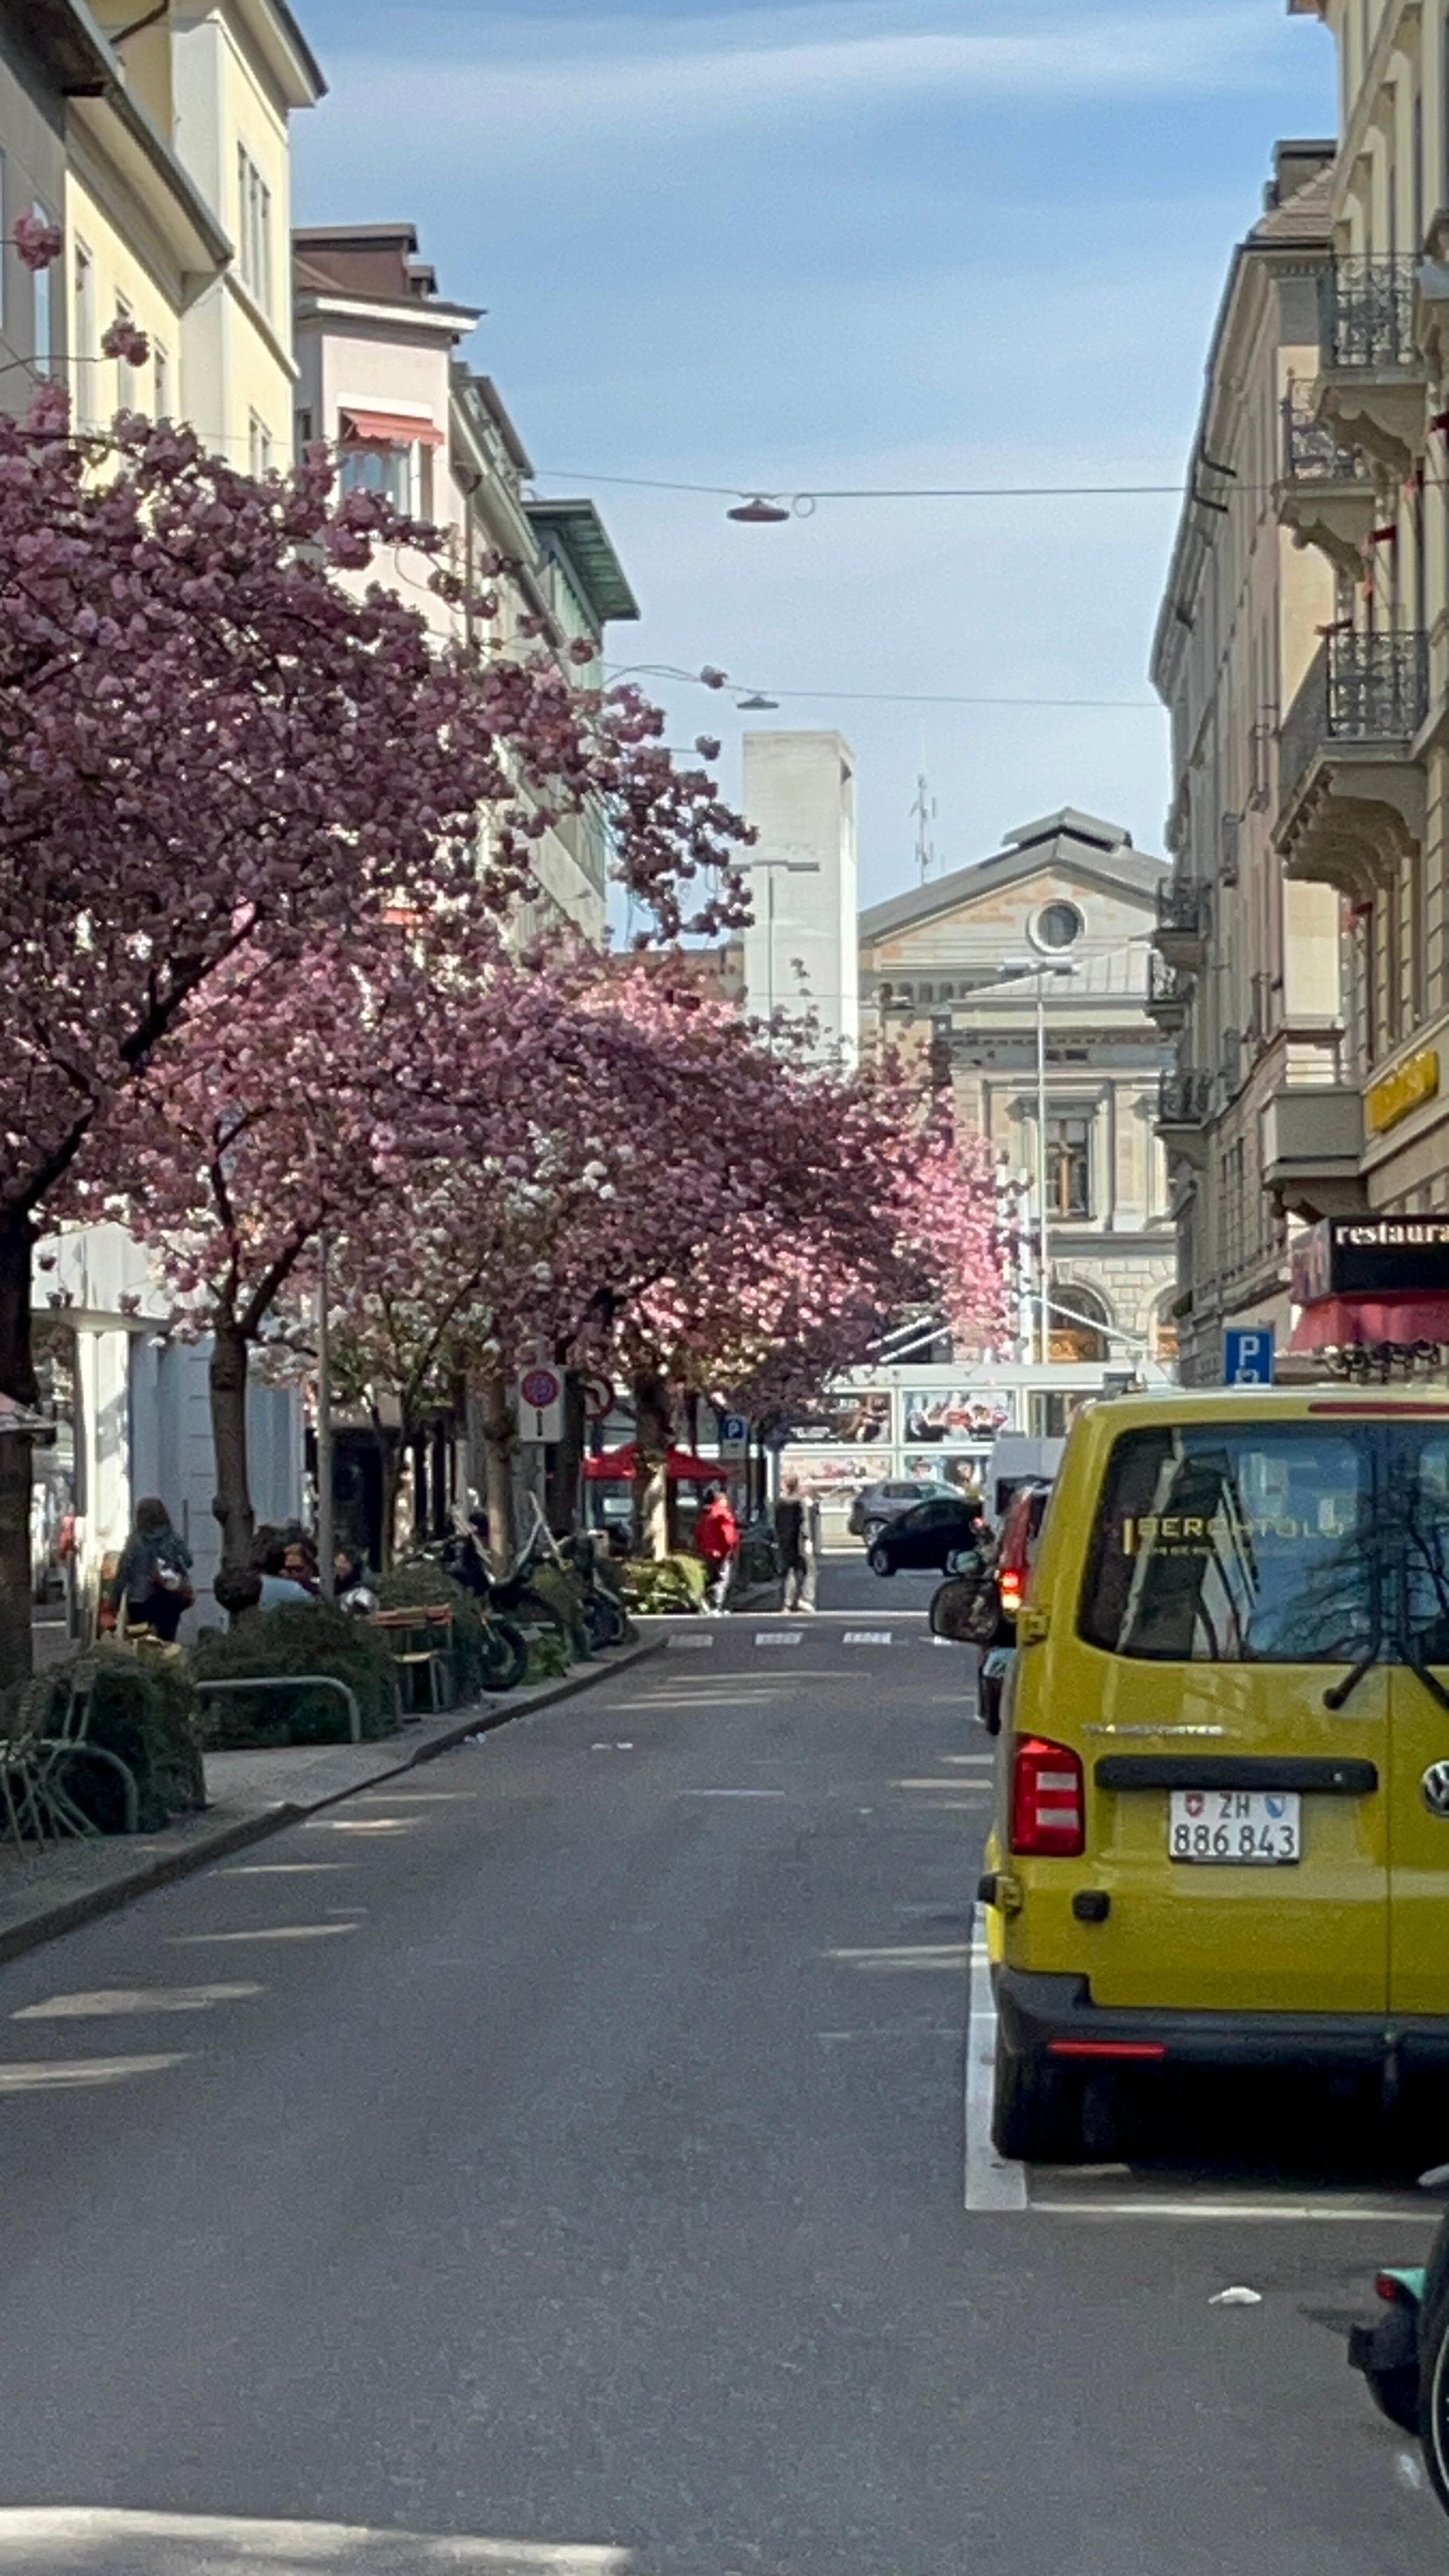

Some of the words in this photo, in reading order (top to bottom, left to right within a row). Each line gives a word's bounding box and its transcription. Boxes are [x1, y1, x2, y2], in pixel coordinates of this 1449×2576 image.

[1239, 1336, 1260, 1367] P
[728, 1420, 740, 1437] P
[1219, 1792, 1251, 1819] ZH
[1174, 1824, 1229, 1856] 886
[1239, 1825, 1295, 1856] 843
